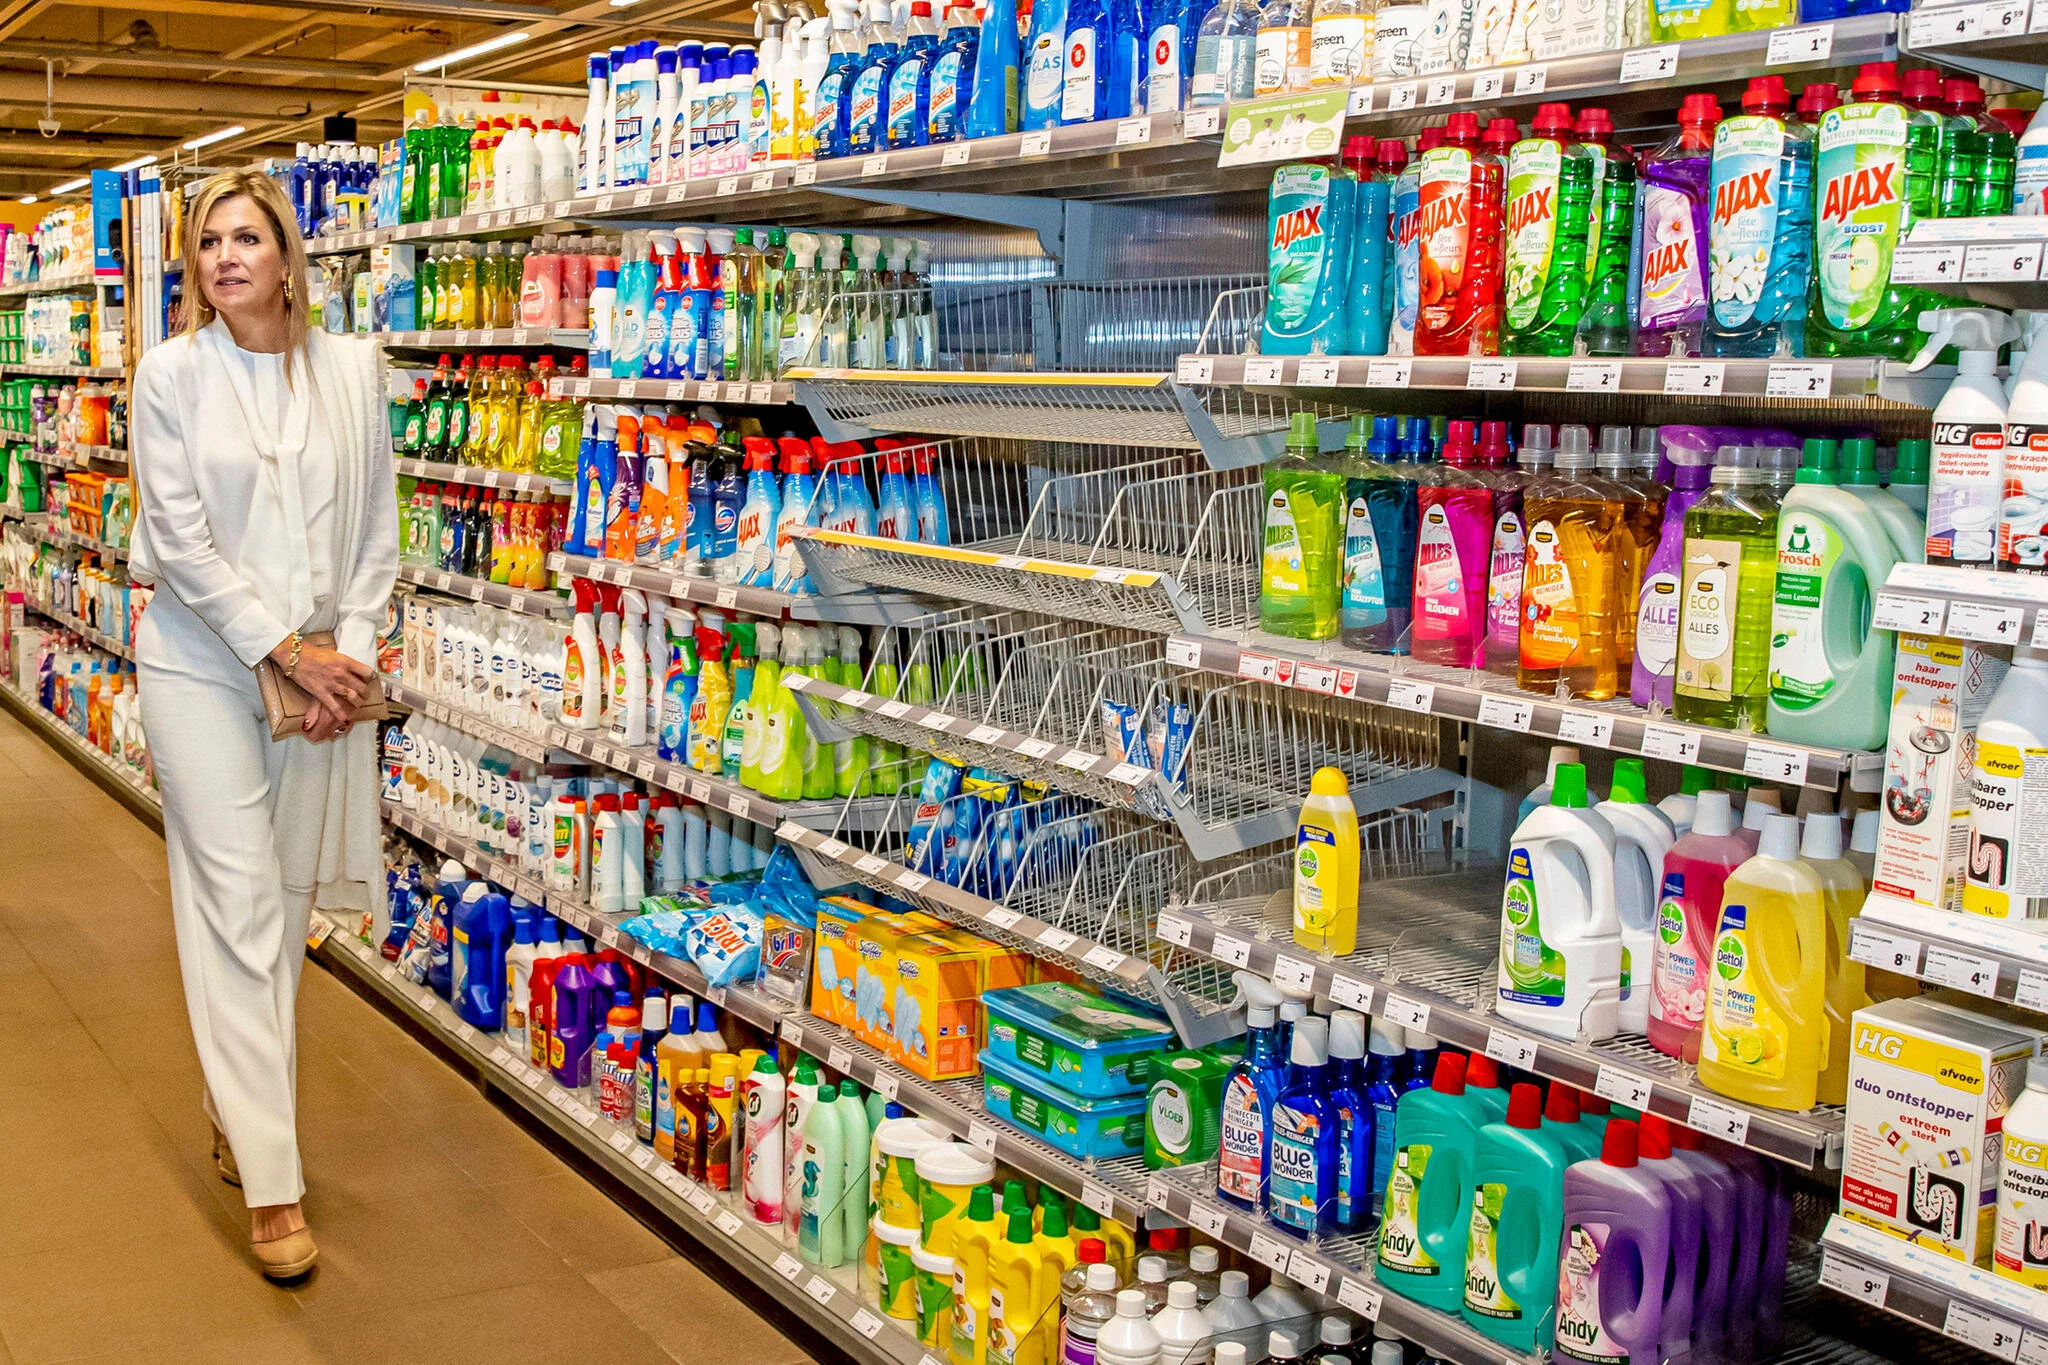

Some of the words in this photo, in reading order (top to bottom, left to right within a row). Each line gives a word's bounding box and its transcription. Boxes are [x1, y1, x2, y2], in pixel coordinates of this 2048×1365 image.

[1844, 105, 1874, 118] NEW
[1714, 168, 1772, 227] AJAX
[1822, 162, 1895, 225] AJAX
[1421, 193, 1466, 242] AJAX
[1508, 186, 1552, 238] AJAX
[1274, 205, 1322, 250] AJAX
[1397, 208, 1421, 250] AJA
[1844, 224, 1884, 234] BOOST
[1644, 239, 1689, 287] AJAX
[1934, 425, 1968, 444] HG
[1974, 436, 2002, 447] toilet
[1778, 550, 1821, 567] Frosch
[1690, 595, 1719, 611] ECO
[1794, 593, 1818, 603] Lemon
[1689, 622, 1719, 635] ALLES
[1903, 637, 1929, 649] HG
[1934, 651, 1960, 661] afvoer
[1915, 662, 1941, 675] haar
[1898, 673, 1957, 690] ontstopper
[1987, 759, 2020, 771] afvoer
[1507, 897, 1529, 914] Dettol
[1660, 914, 1683, 932] Dettol
[772, 932, 803, 950] brillo
[1516, 933, 1540, 945] POWER
[1669, 952, 1695, 966] POWER
[1717, 950, 1743, 968] Dettol
[1727, 988, 1756, 1004] POWER
[1857, 1028, 1903, 1060] HG
[1940, 1067, 1980, 1086] afvoer
[1854, 1078, 1881, 1095] duo
[1886, 1089, 1974, 1123] ontstopper
[1158, 1105, 1183, 1125] VLOER
[1899, 1113, 1951, 1137] extreem
[1911, 1128, 1937, 1143] sterk
[2007, 1139, 2041, 1163] HG
[1381, 1229, 1415, 1257] Andy
[1465, 1270, 1496, 1301] Andy
[1558, 1312, 1599, 1346] Andy
